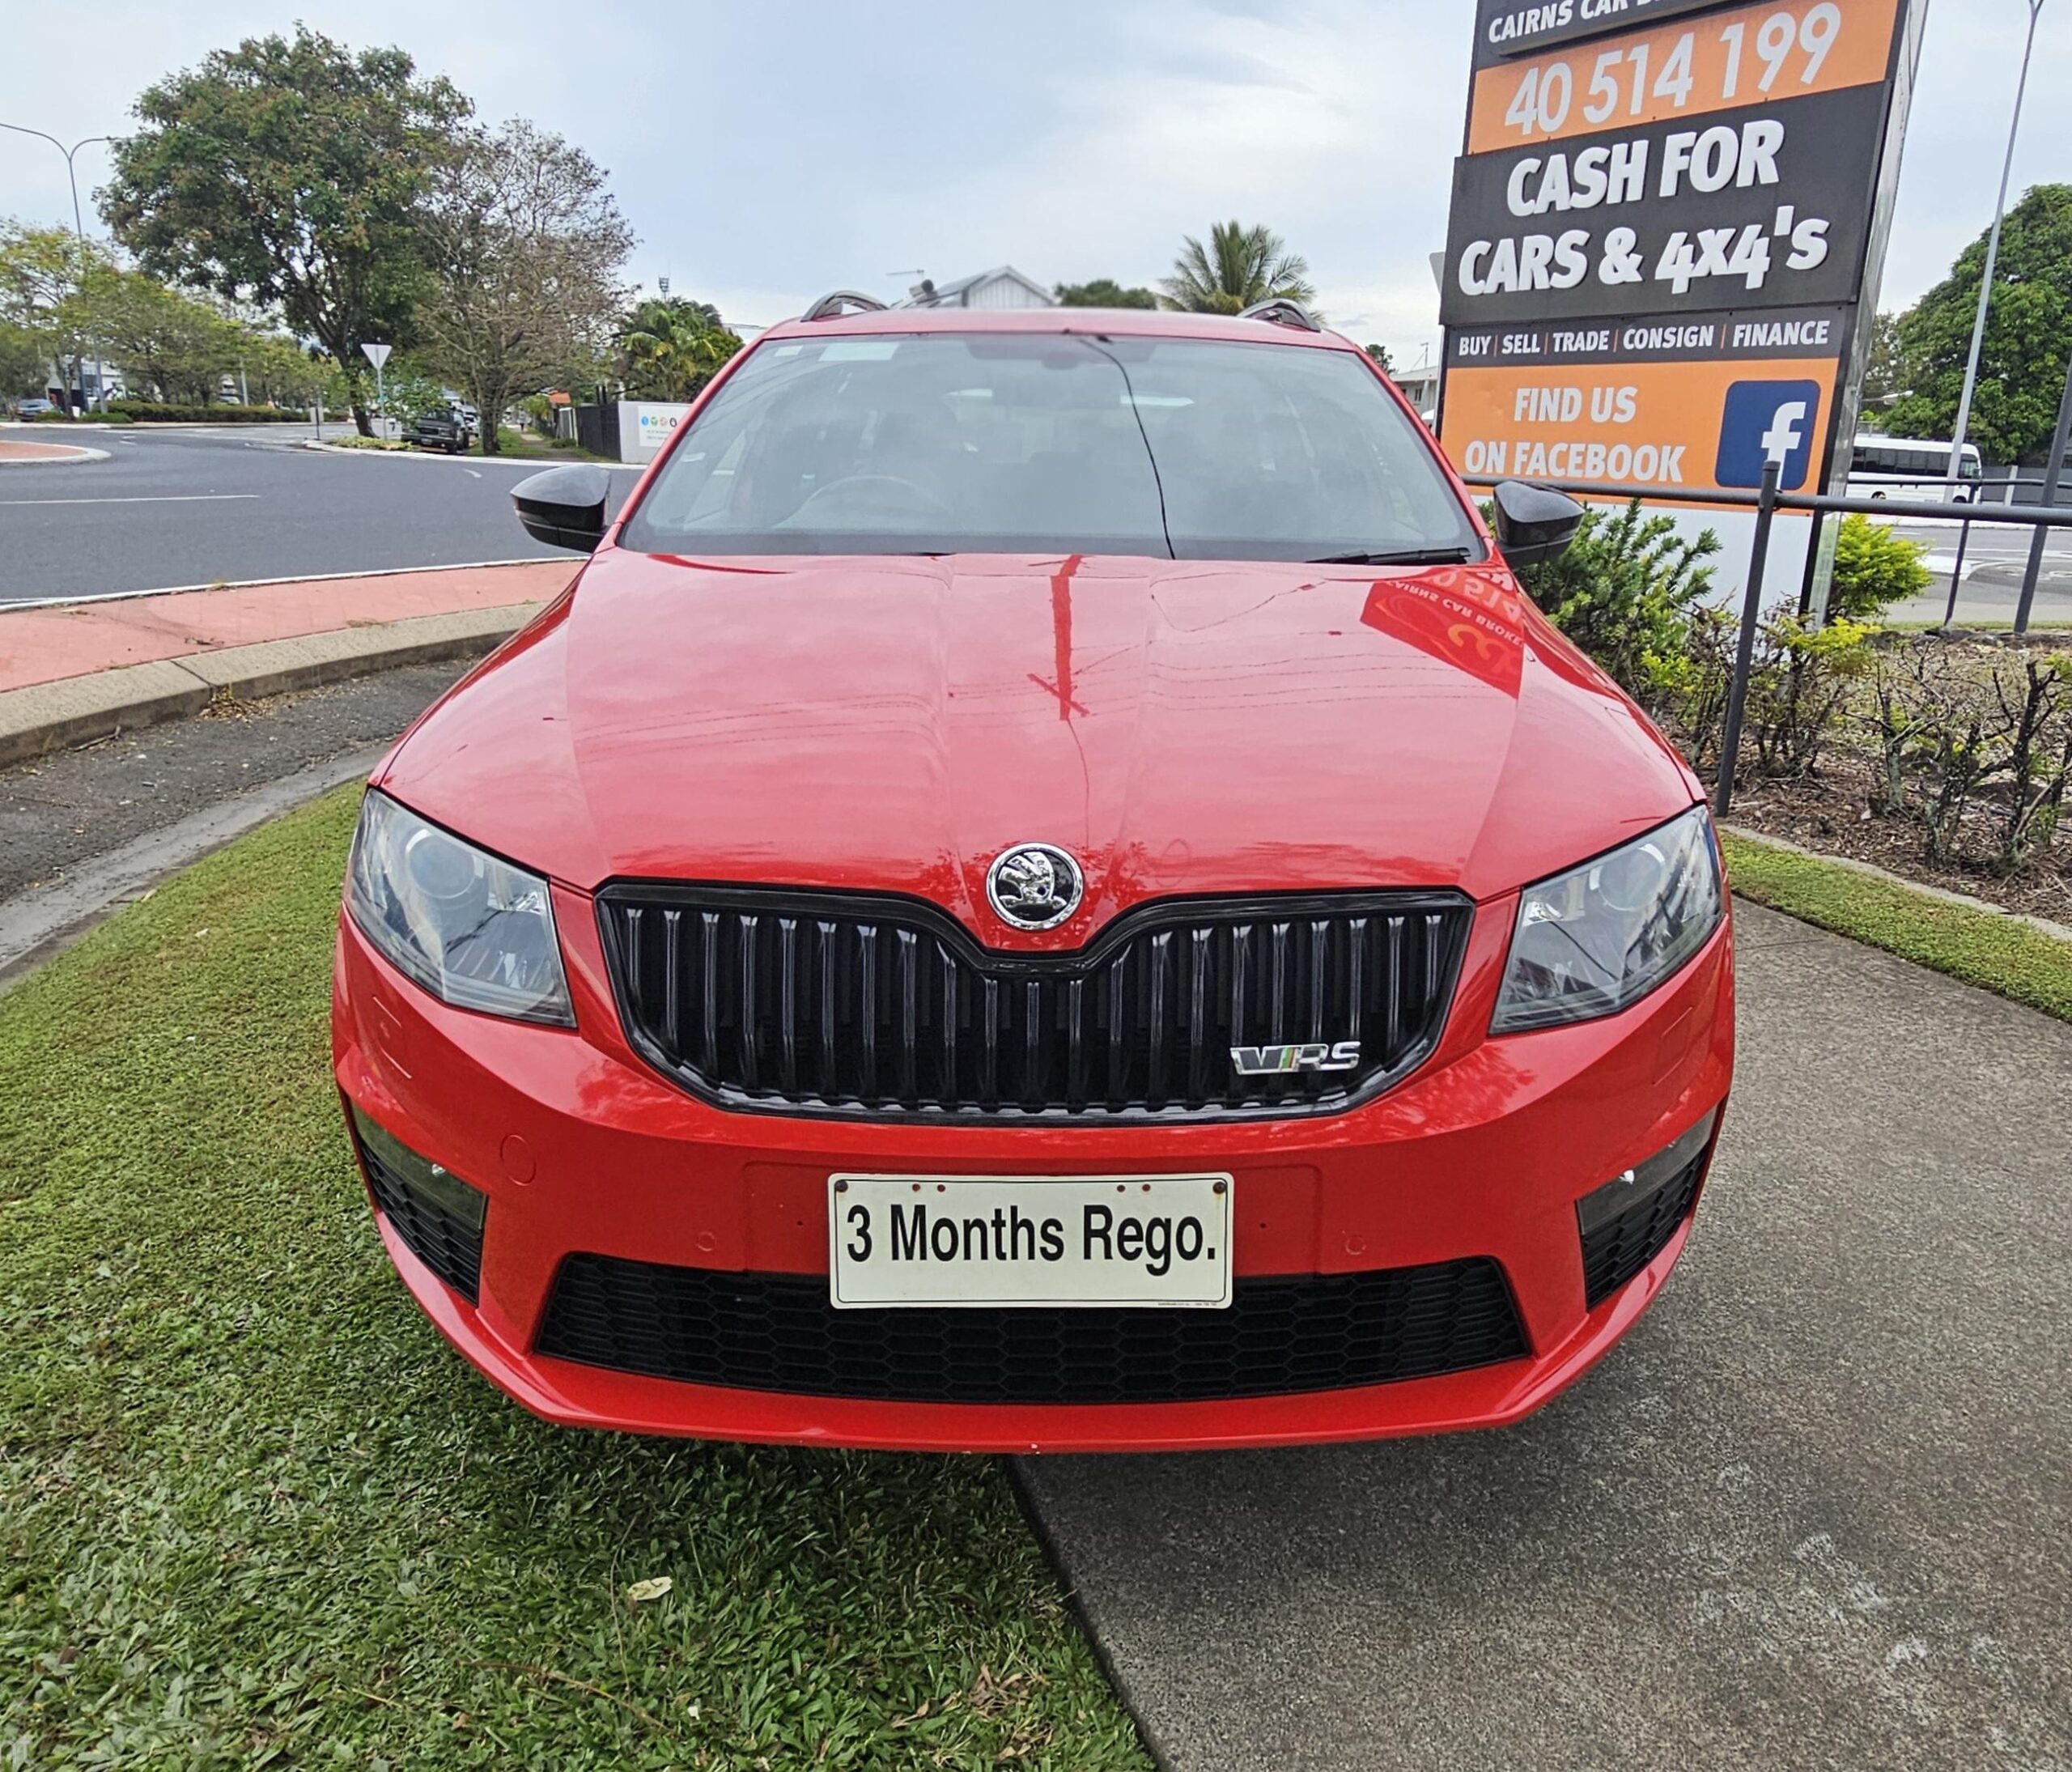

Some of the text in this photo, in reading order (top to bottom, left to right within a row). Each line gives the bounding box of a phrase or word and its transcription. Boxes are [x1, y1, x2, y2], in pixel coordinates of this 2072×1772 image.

[1488, 0, 1573, 43] CAIRNS
[1504, 2, 1841, 136] 40 514 199
[1507, 119, 1785, 217] CASH FOR
[1458, 229, 1590, 295] CARS
[1598, 227, 1643, 285] &
[1458, 321, 1831, 355] BUY SELL TRADE CONSIGN FINANCE
[1514, 386, 1638, 423] FIND US
[1464, 440, 1687, 482] ON FACEBOOK
[847, 1204, 1216, 1277] 3 Months Rego.
